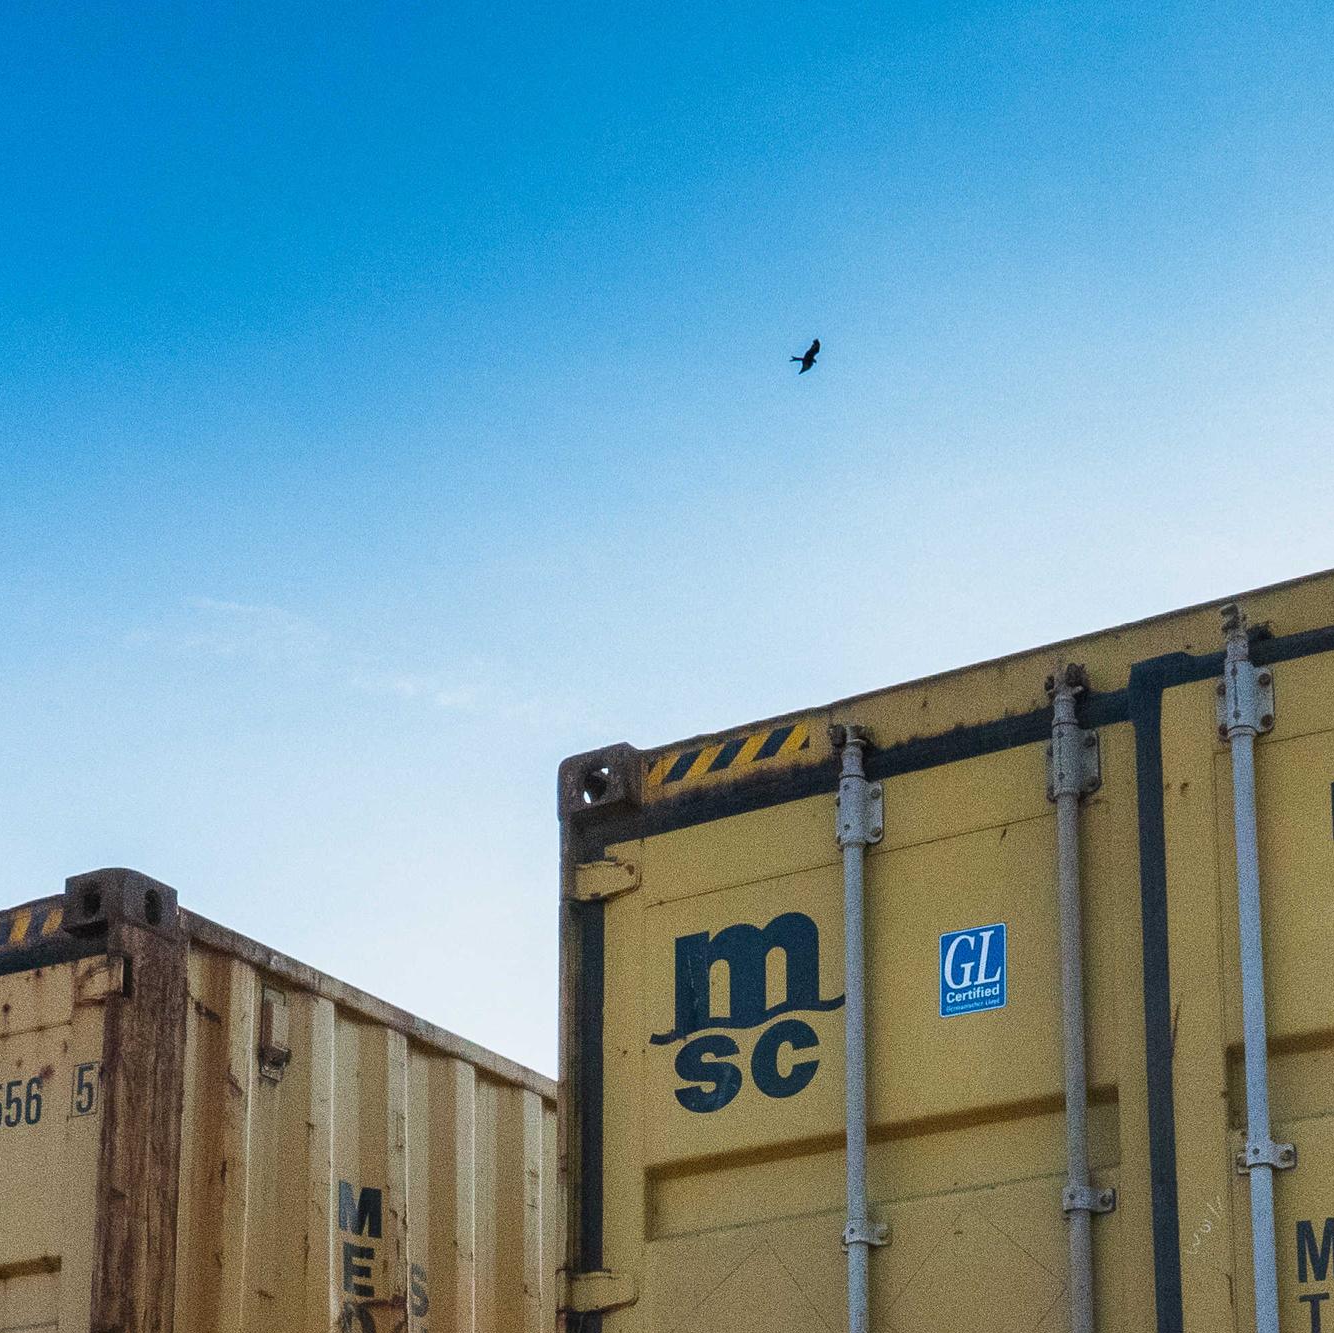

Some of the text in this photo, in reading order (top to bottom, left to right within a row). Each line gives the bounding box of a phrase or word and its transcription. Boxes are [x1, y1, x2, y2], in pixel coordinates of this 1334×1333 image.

[944, 930, 1002, 989] GL
[946, 983, 1000, 1004] Certified
[74, 1064, 96, 1113] 5
